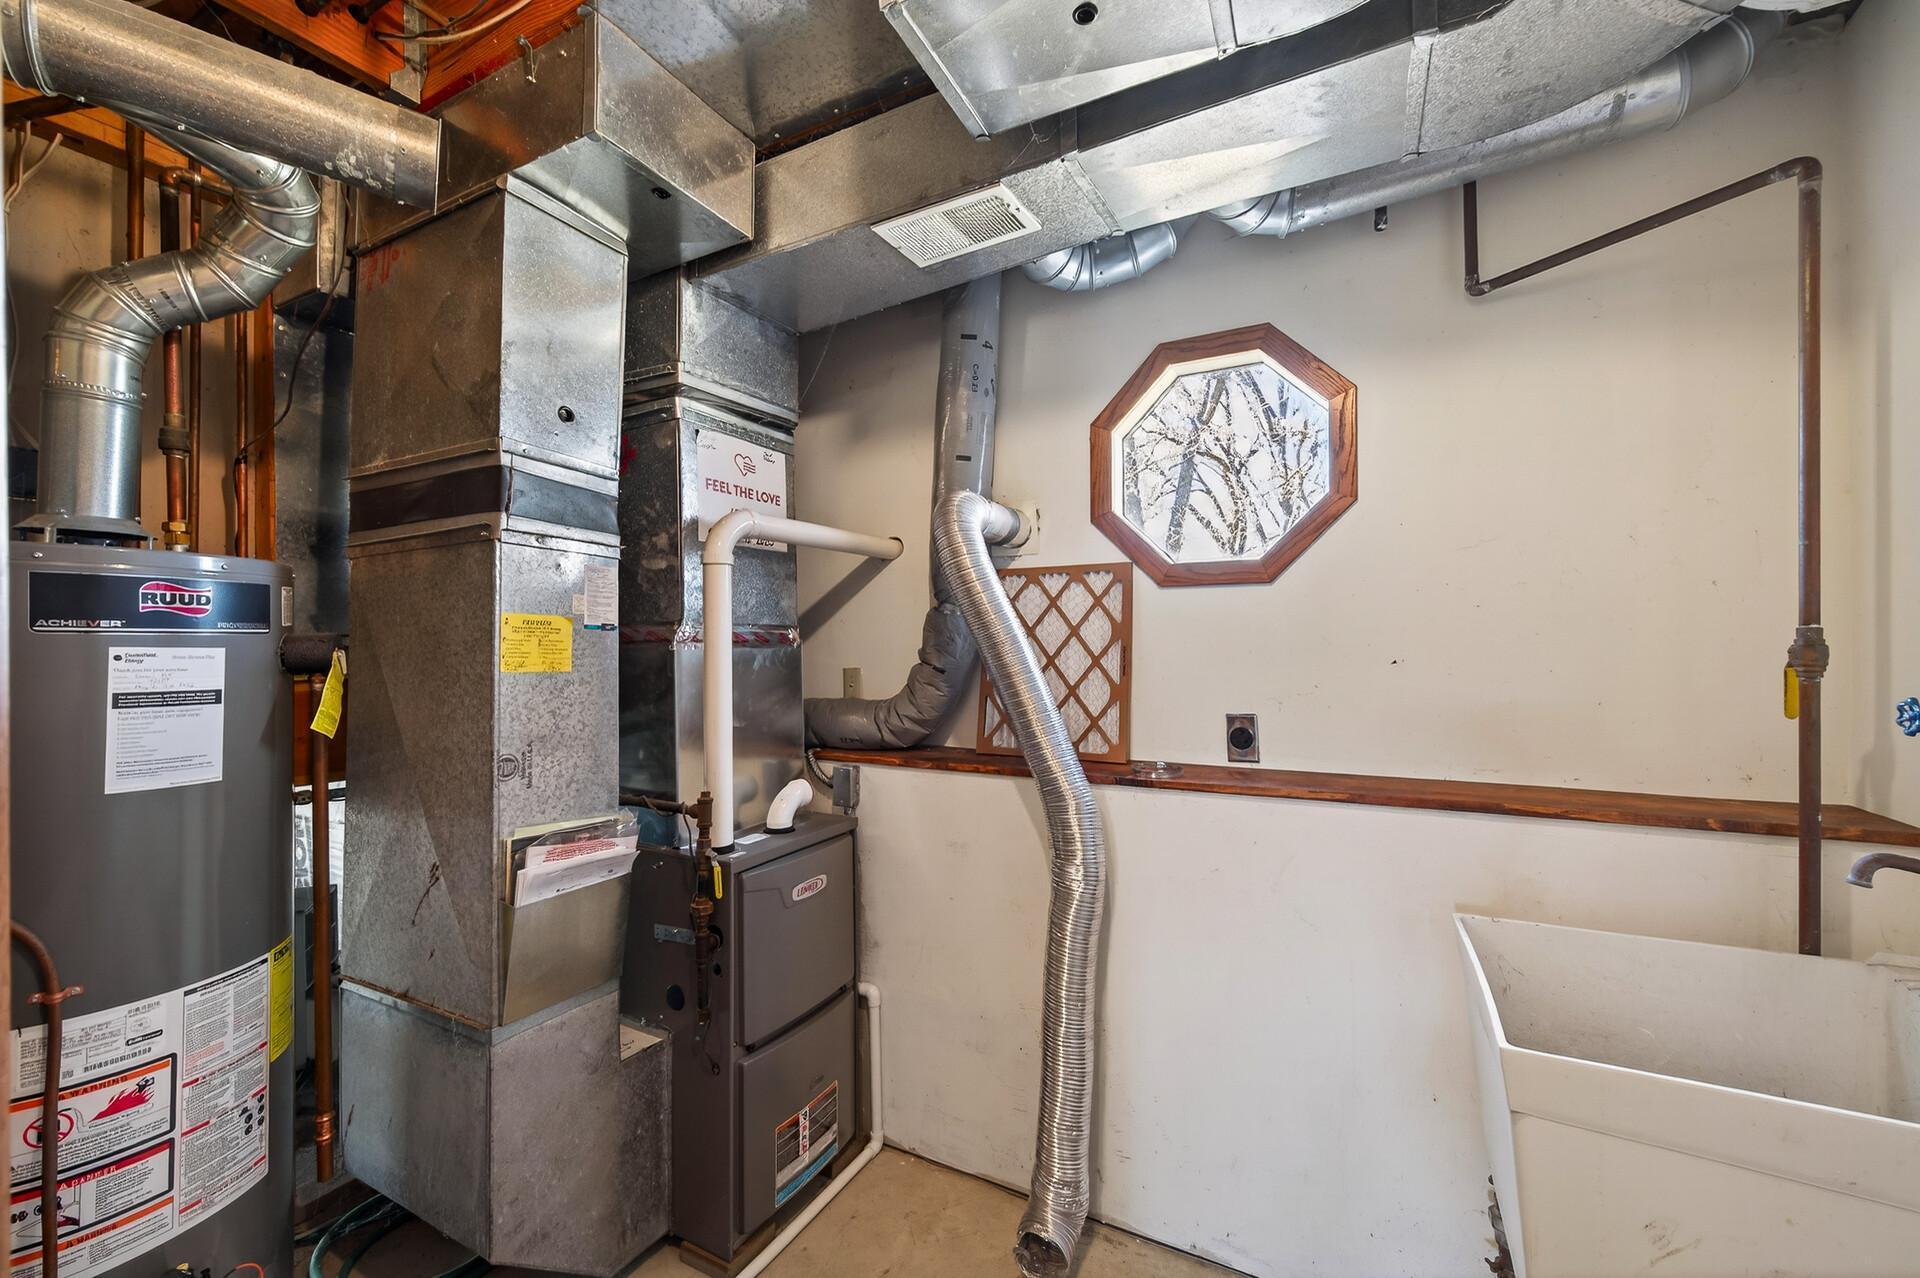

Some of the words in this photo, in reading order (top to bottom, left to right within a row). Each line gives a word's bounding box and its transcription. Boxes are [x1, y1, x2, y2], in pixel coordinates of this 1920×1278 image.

[705, 478, 732, 494] FEEL
[733, 484, 754, 500] THE
[756, 490, 781, 506] LOVE
[141, 592, 211, 606] RUUD
[34, 618, 121, 628] ACHIEVER
